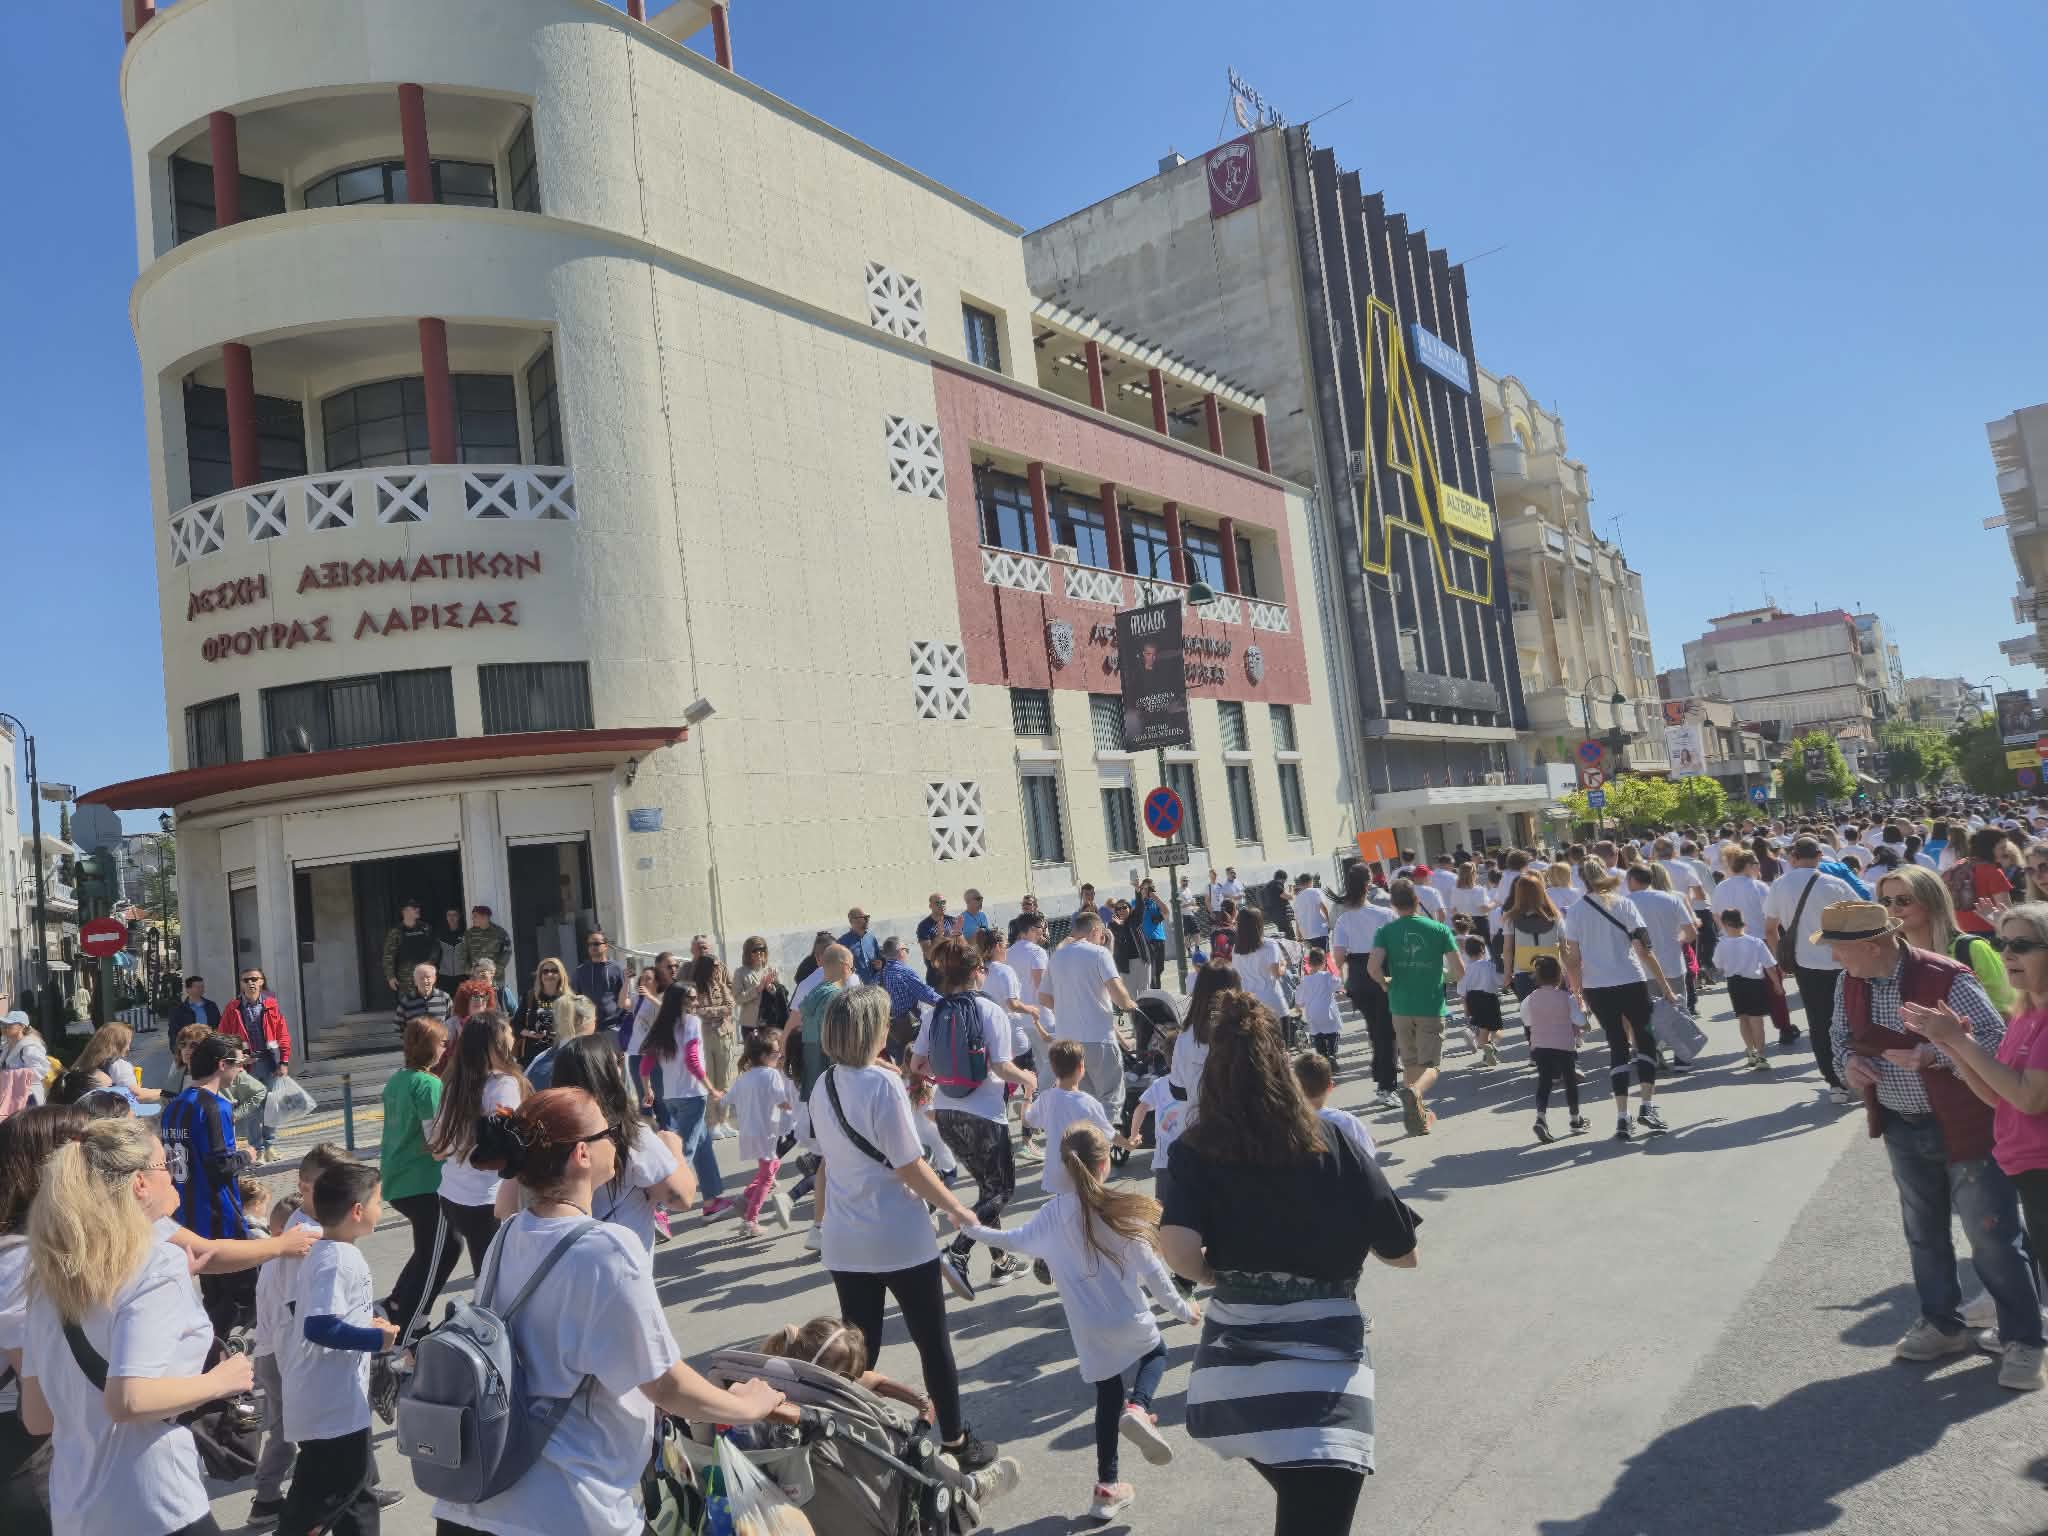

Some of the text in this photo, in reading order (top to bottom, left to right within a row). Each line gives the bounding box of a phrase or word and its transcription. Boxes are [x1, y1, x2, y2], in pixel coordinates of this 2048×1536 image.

[187, 550, 542, 621] ΛΕΣΧΗ ΑΞΙΩΜΑΤΙΚΩΝ
[201, 600, 519, 662] ΦΡΟΥΡΑΣ ΛΑΡΙΣΑΣ
